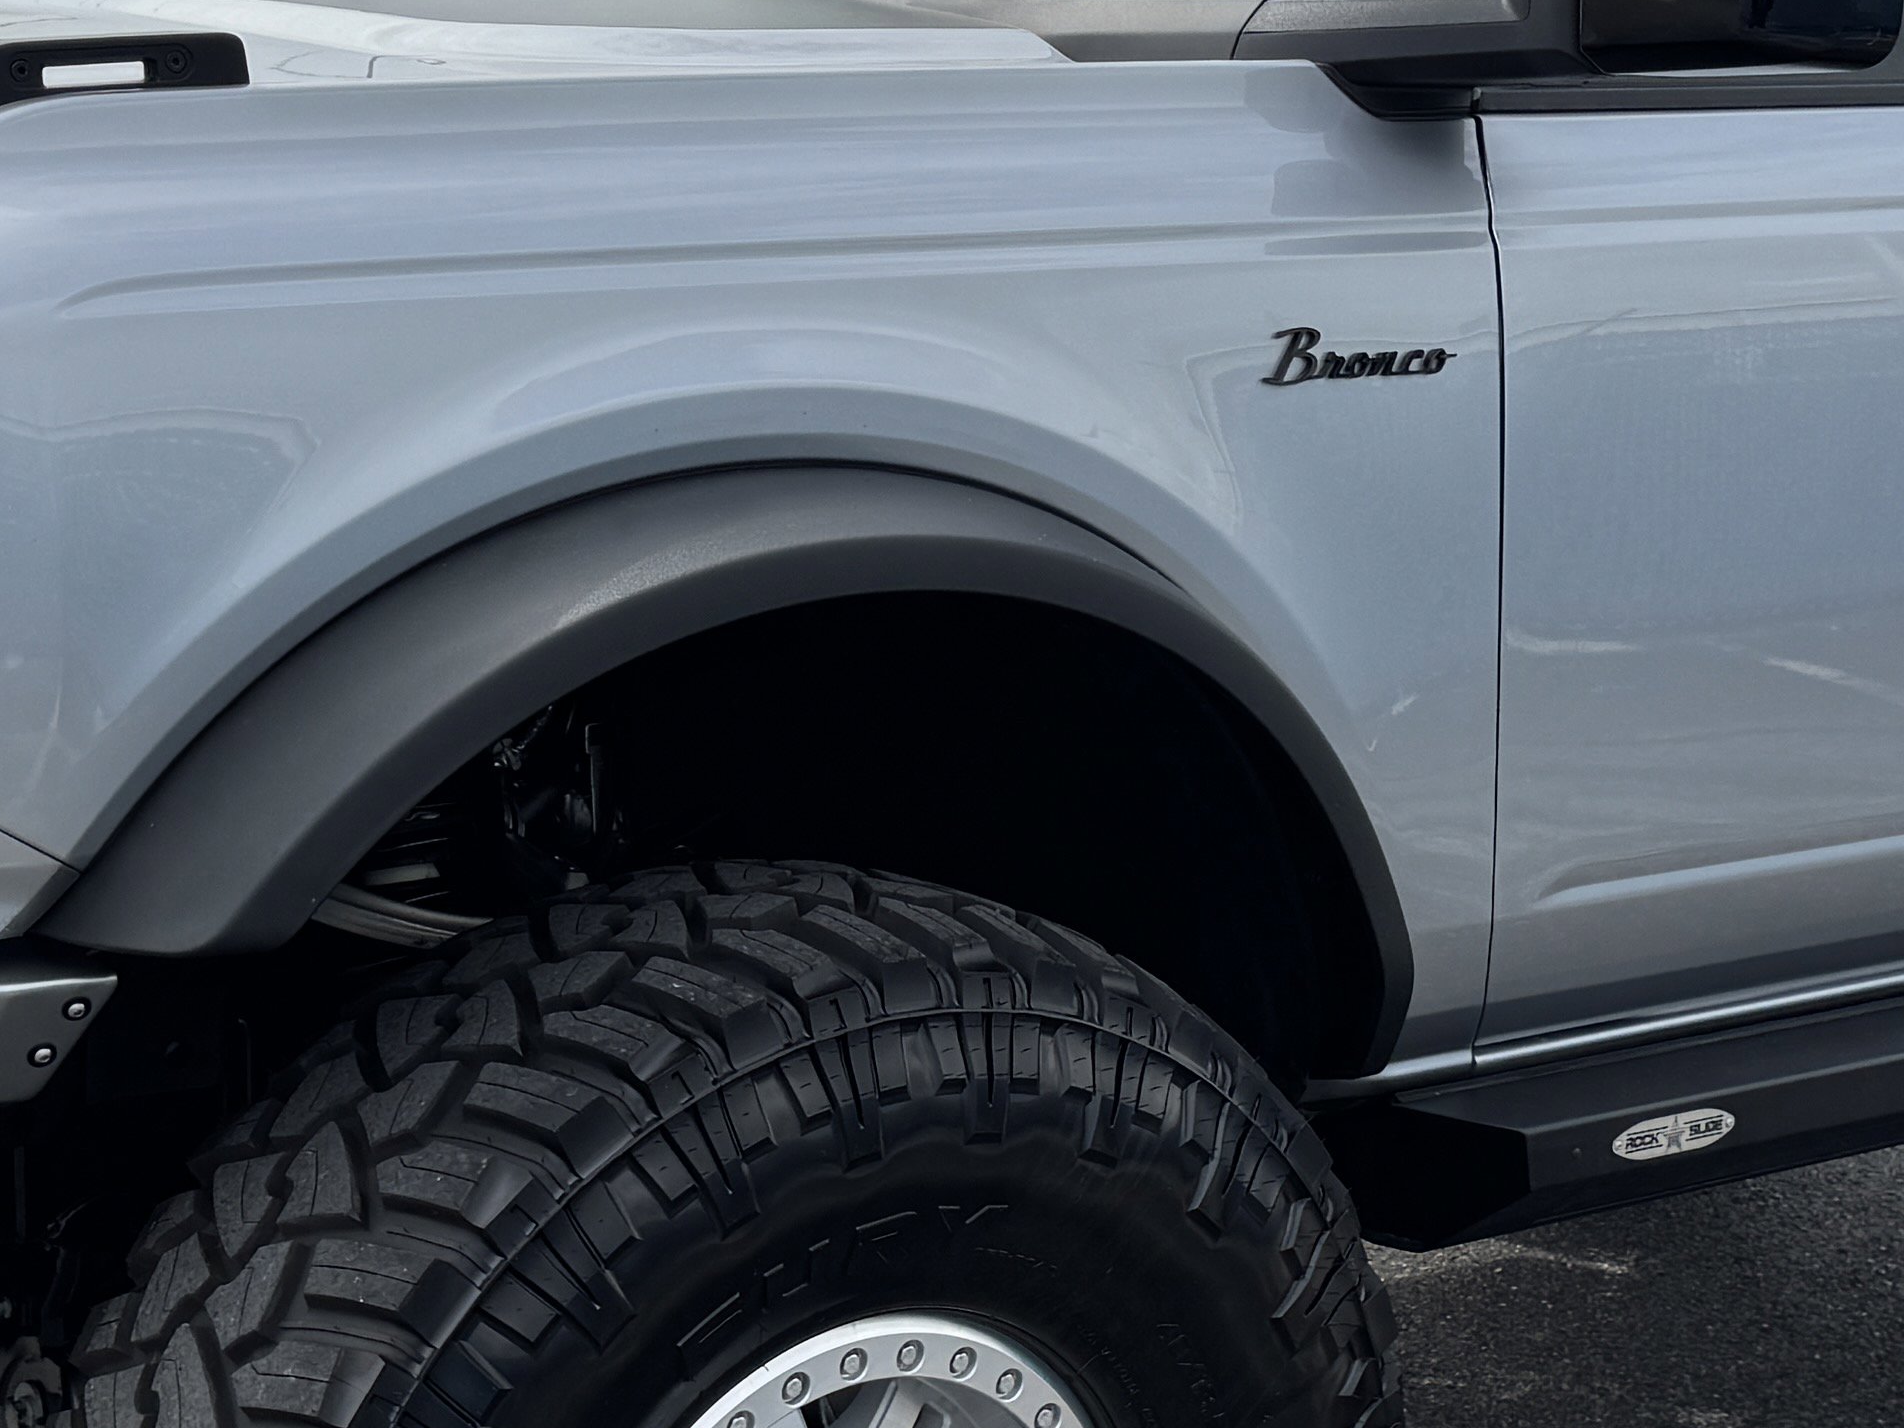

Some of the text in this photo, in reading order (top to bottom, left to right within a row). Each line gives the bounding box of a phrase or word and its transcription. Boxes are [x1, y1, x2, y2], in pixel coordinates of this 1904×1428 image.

[1259, 327, 1457, 385] Bronco
[1625, 1119, 1723, 1150] ROCK SLIDE
